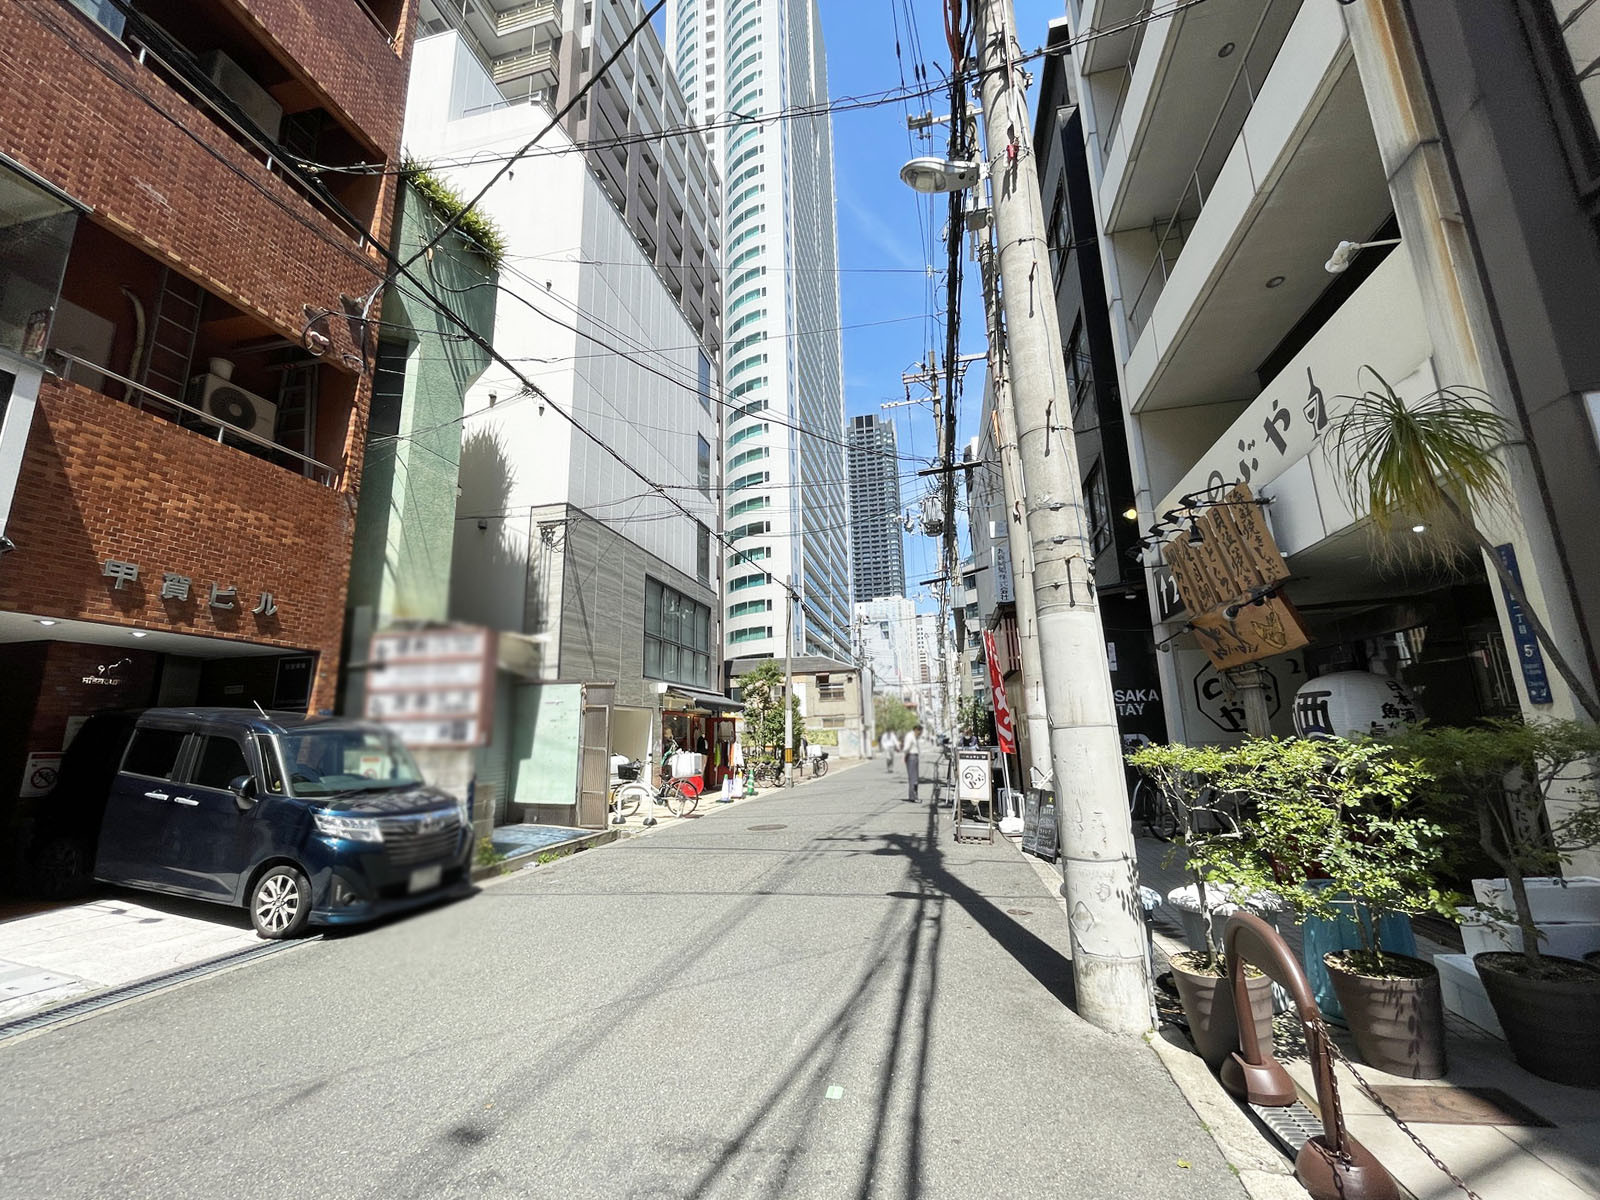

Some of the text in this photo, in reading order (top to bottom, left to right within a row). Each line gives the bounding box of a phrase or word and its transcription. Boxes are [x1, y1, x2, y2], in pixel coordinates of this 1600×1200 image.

[102, 558, 279, 616] 甲賀ビル
[1523, 644, 1534, 658] 5
[1114, 689, 1160, 702] SAKA
[1115, 703, 1145, 716] TAY
